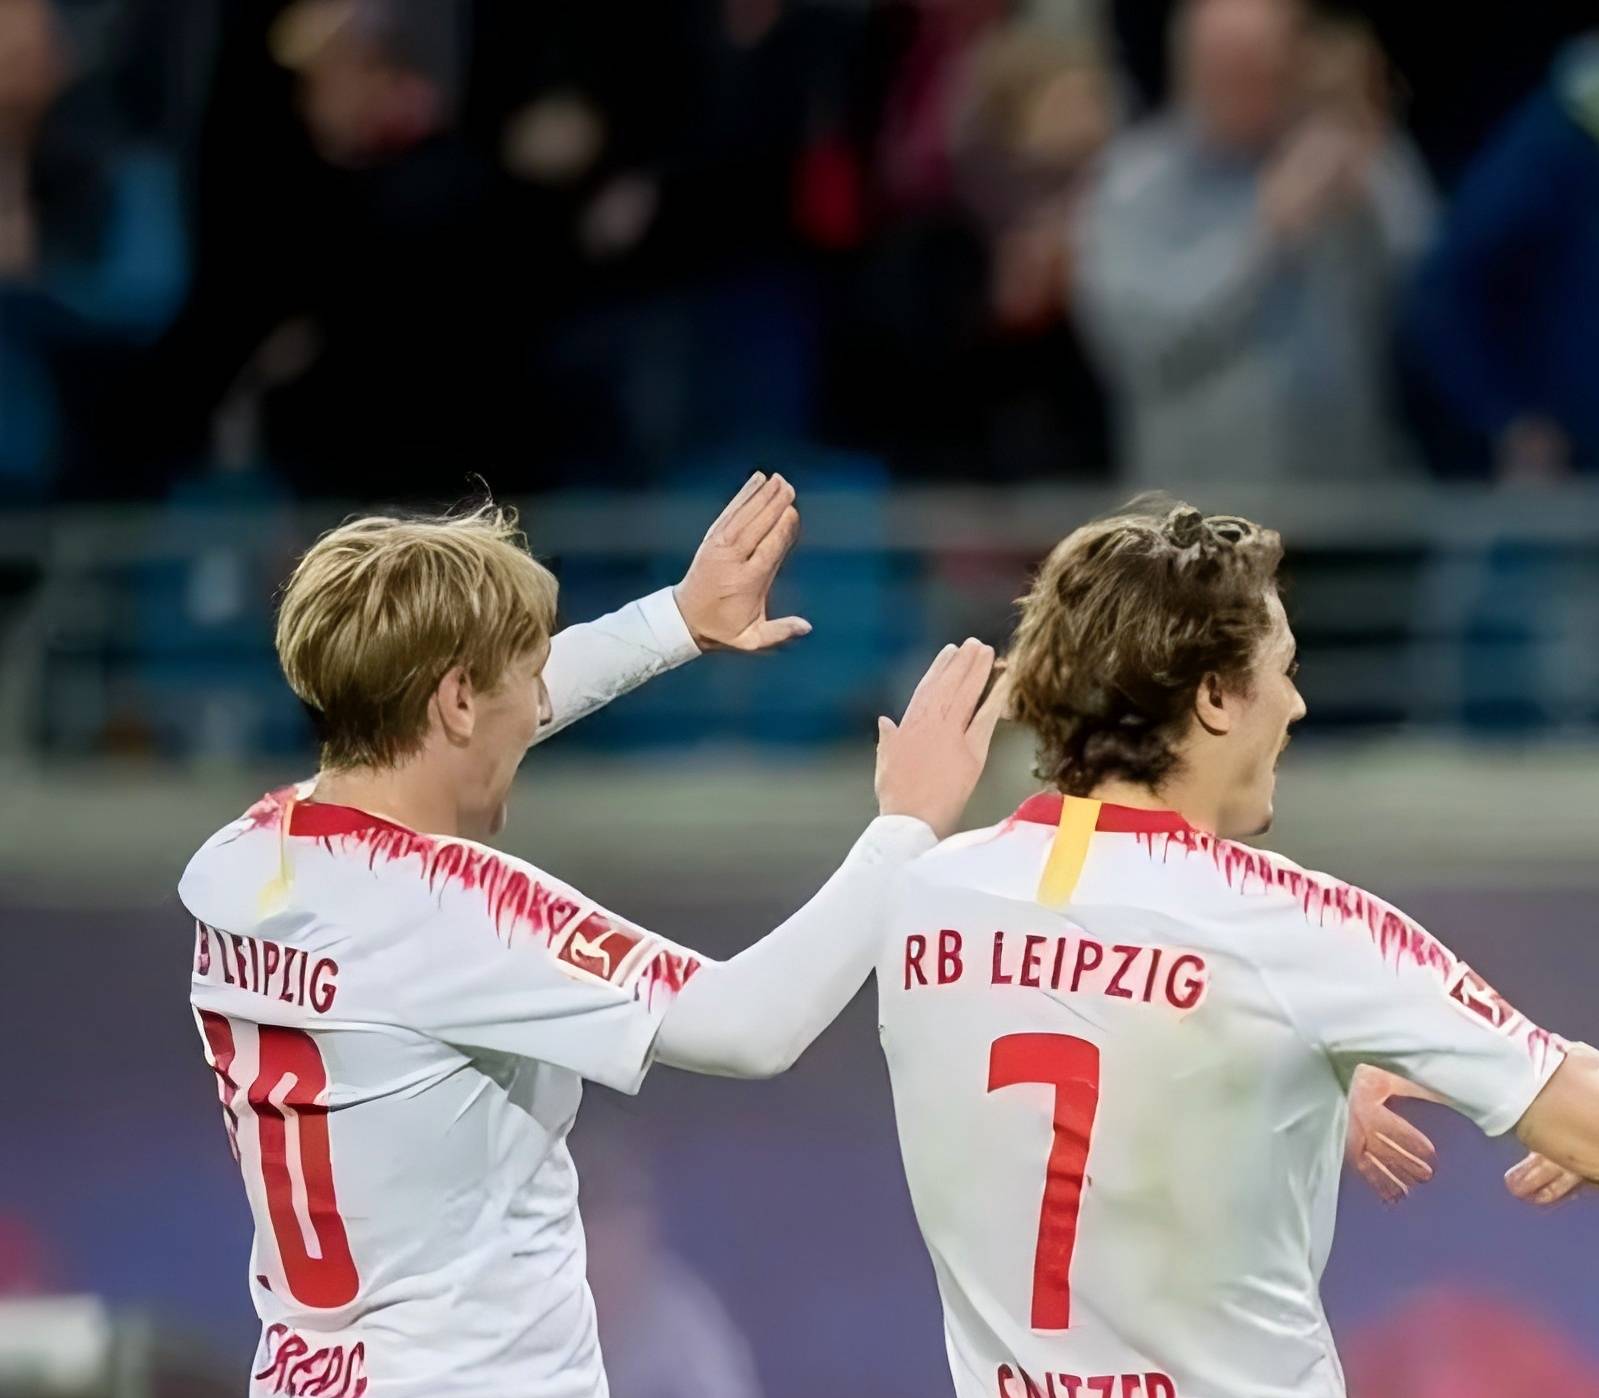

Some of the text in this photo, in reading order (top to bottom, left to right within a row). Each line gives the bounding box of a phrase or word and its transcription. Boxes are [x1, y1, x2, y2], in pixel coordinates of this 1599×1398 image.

[903, 928, 1207, 1010] RB LEIPZIG
[986, 1032, 1100, 1331] 7
